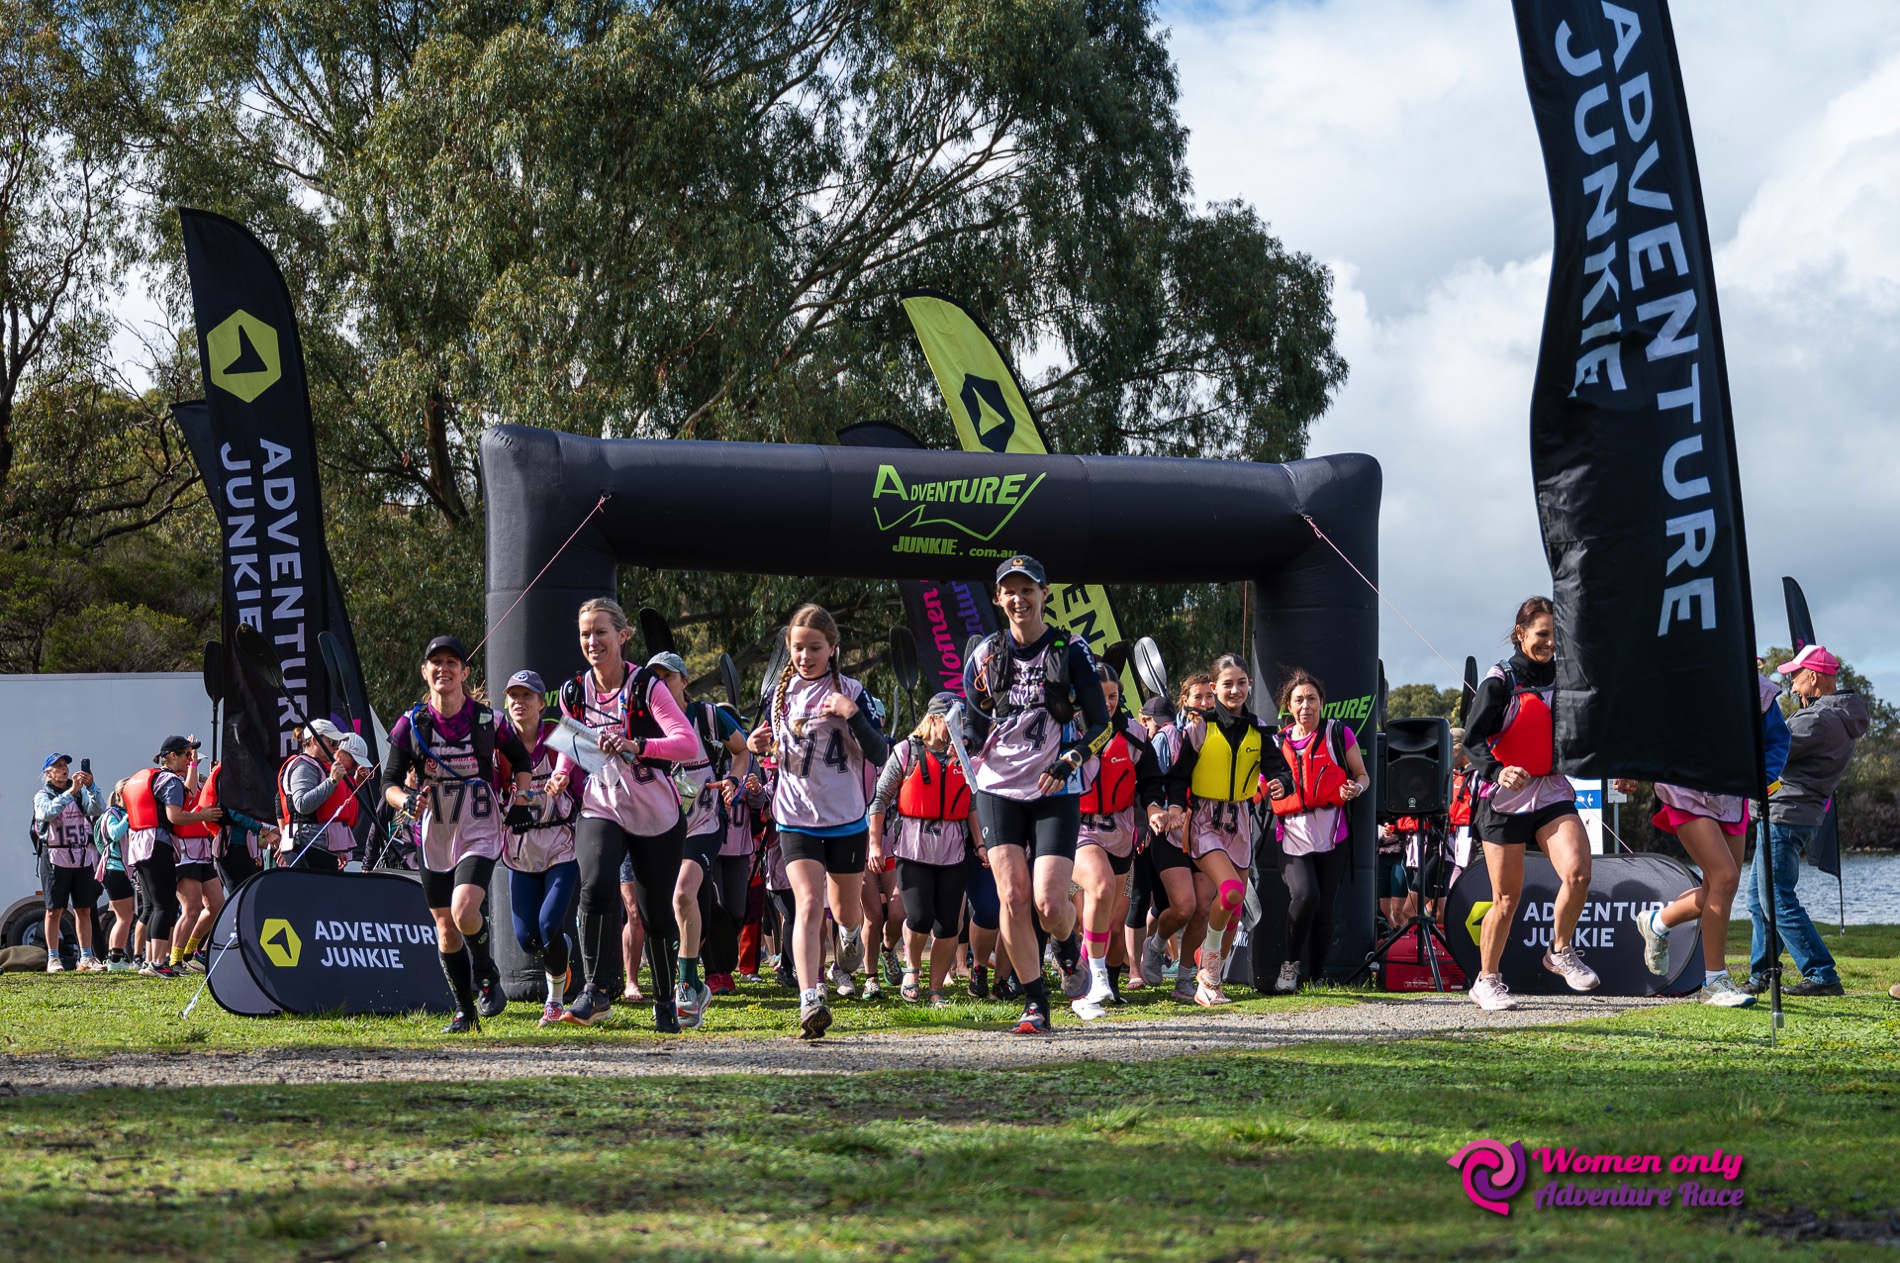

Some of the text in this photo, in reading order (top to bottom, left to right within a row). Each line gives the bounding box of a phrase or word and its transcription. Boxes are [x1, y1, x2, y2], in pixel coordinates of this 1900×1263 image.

[1555, 20, 1627, 397] JUNKIE
[1601, 0, 1716, 637] ADVENTURE
[872, 464, 1027, 505] ADVENTURE
[220, 441, 264, 634] JUNKIE
[260, 438, 308, 758] ADVENTURE
[430, 781, 494, 824] 178
[315, 920, 438, 945] ADVENTUR
[1523, 927, 1615, 947] JUKIE
[320, 947, 404, 969] JUNKIE
